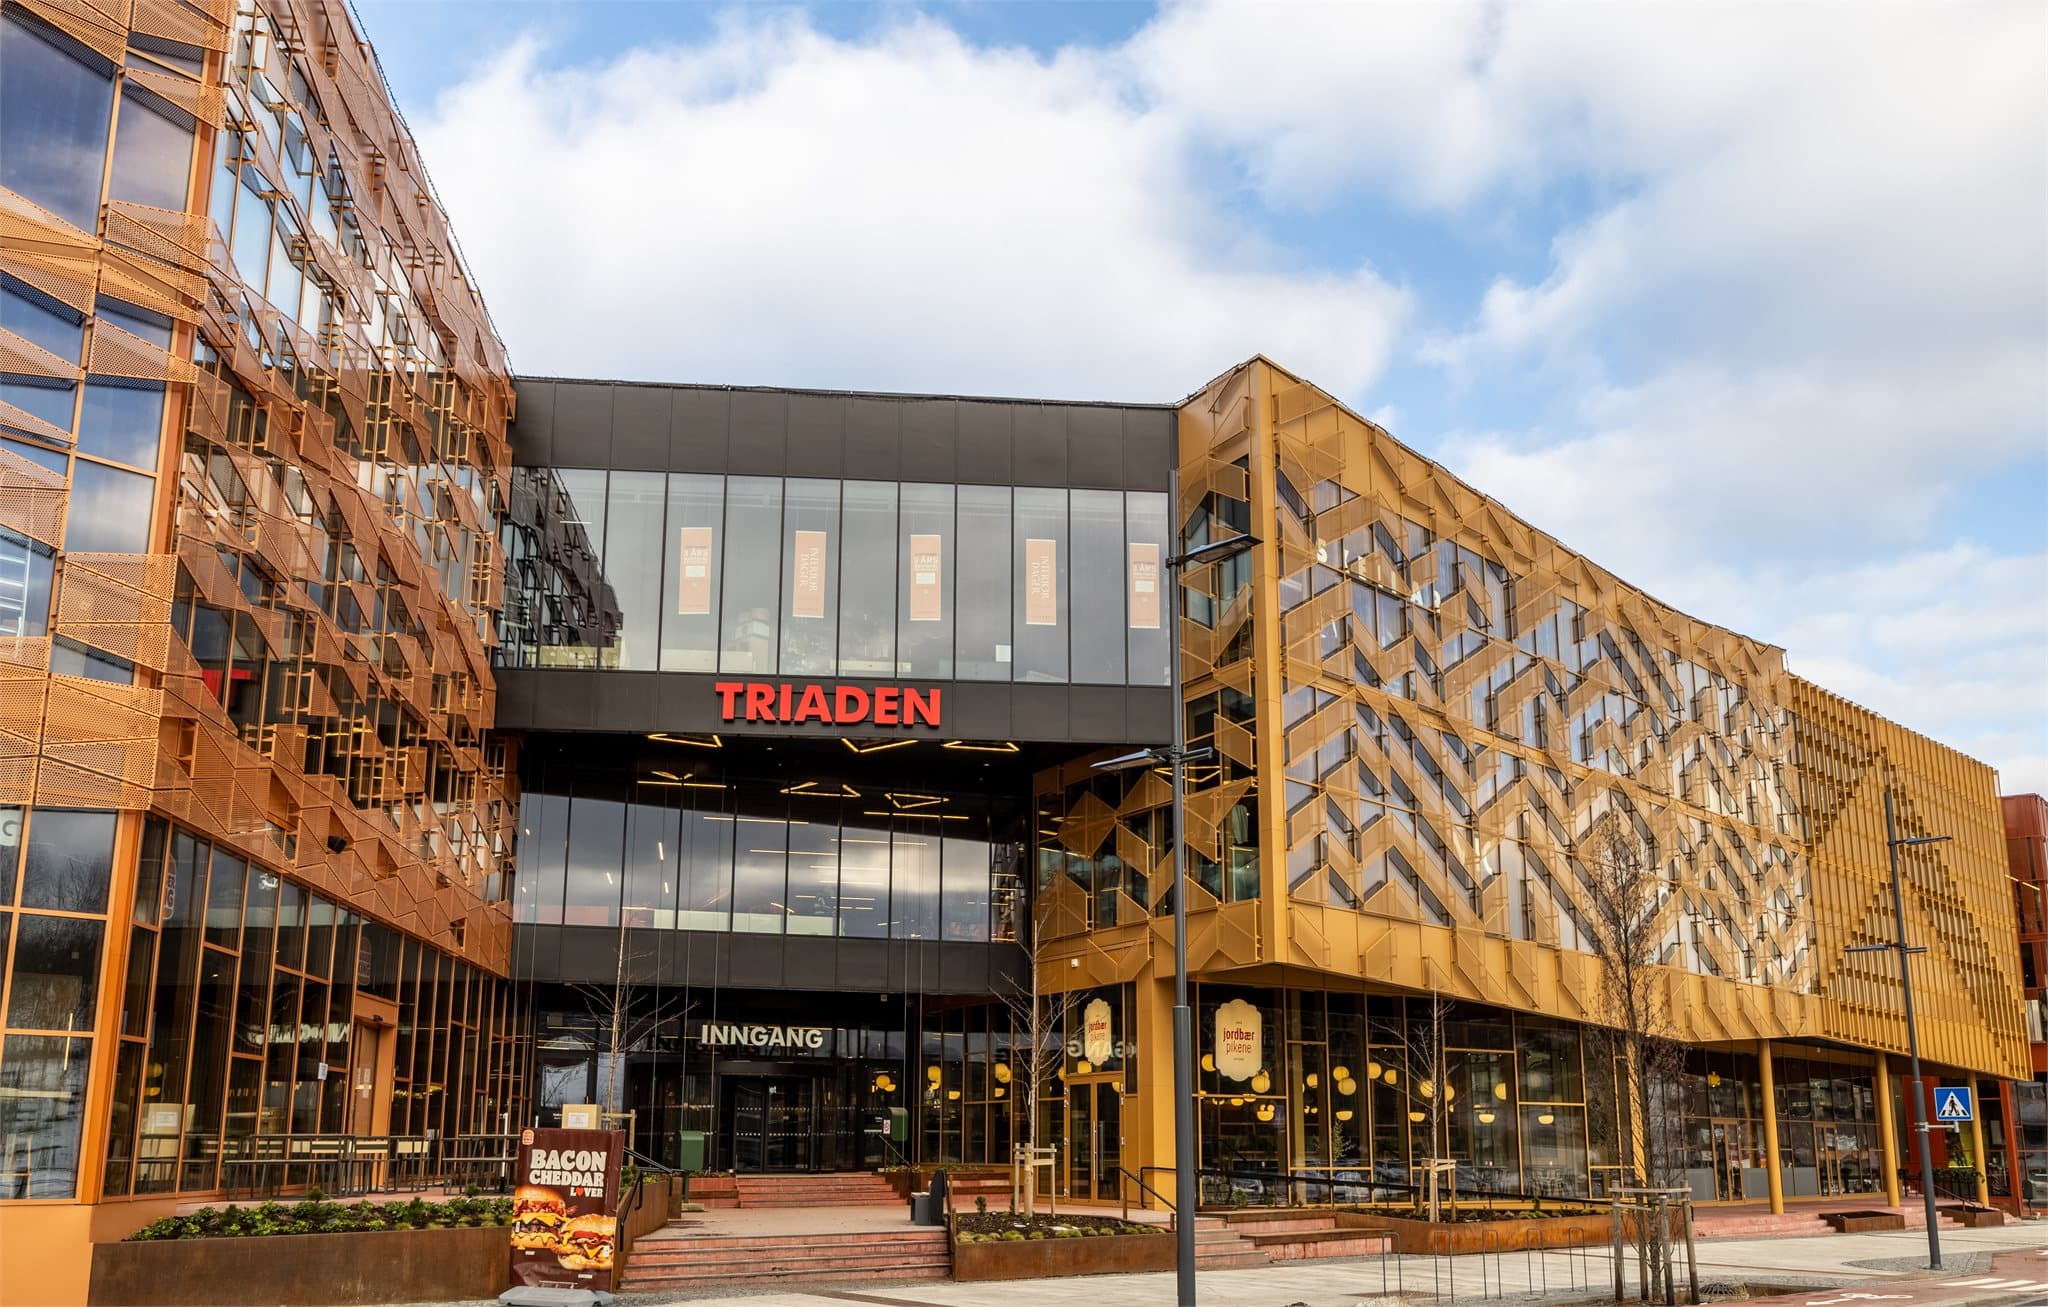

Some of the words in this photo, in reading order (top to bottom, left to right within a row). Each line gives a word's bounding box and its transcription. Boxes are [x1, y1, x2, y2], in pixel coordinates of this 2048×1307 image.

[715, 682, 941, 727] TRIADEN
[701, 1025, 823, 1048] INNGANG
[1223, 1027, 1255, 1042] jordbær
[1226, 1040, 1252, 1055] pikene
[530, 1149, 607, 1172] BACON
[529, 1169, 605, 1188] CHEDDAR
